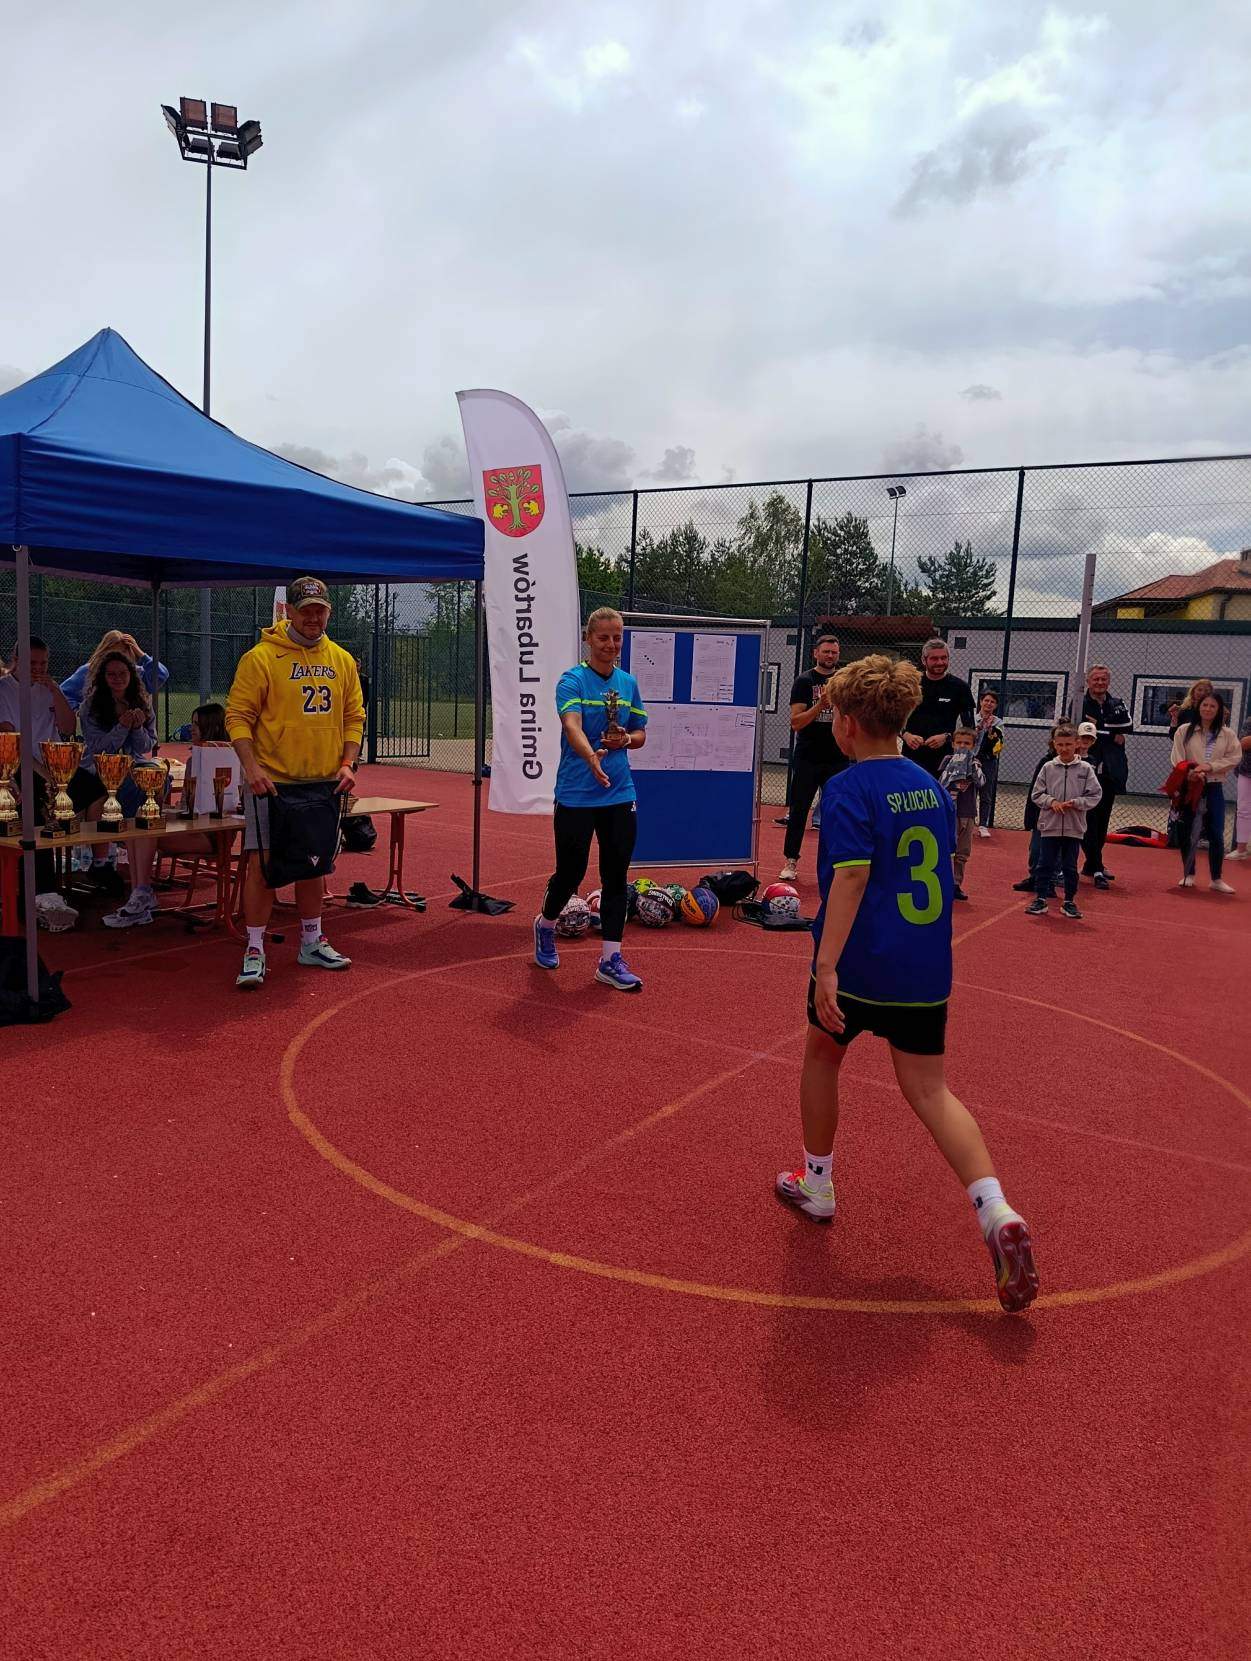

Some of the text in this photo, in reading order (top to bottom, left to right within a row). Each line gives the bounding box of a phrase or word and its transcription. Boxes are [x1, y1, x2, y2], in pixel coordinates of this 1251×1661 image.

[289, 662, 336, 680] LAKERS
[302, 685, 332, 714] 23
[886, 788, 939, 814] SPŁUCKA
[896, 825, 943, 925] 3
